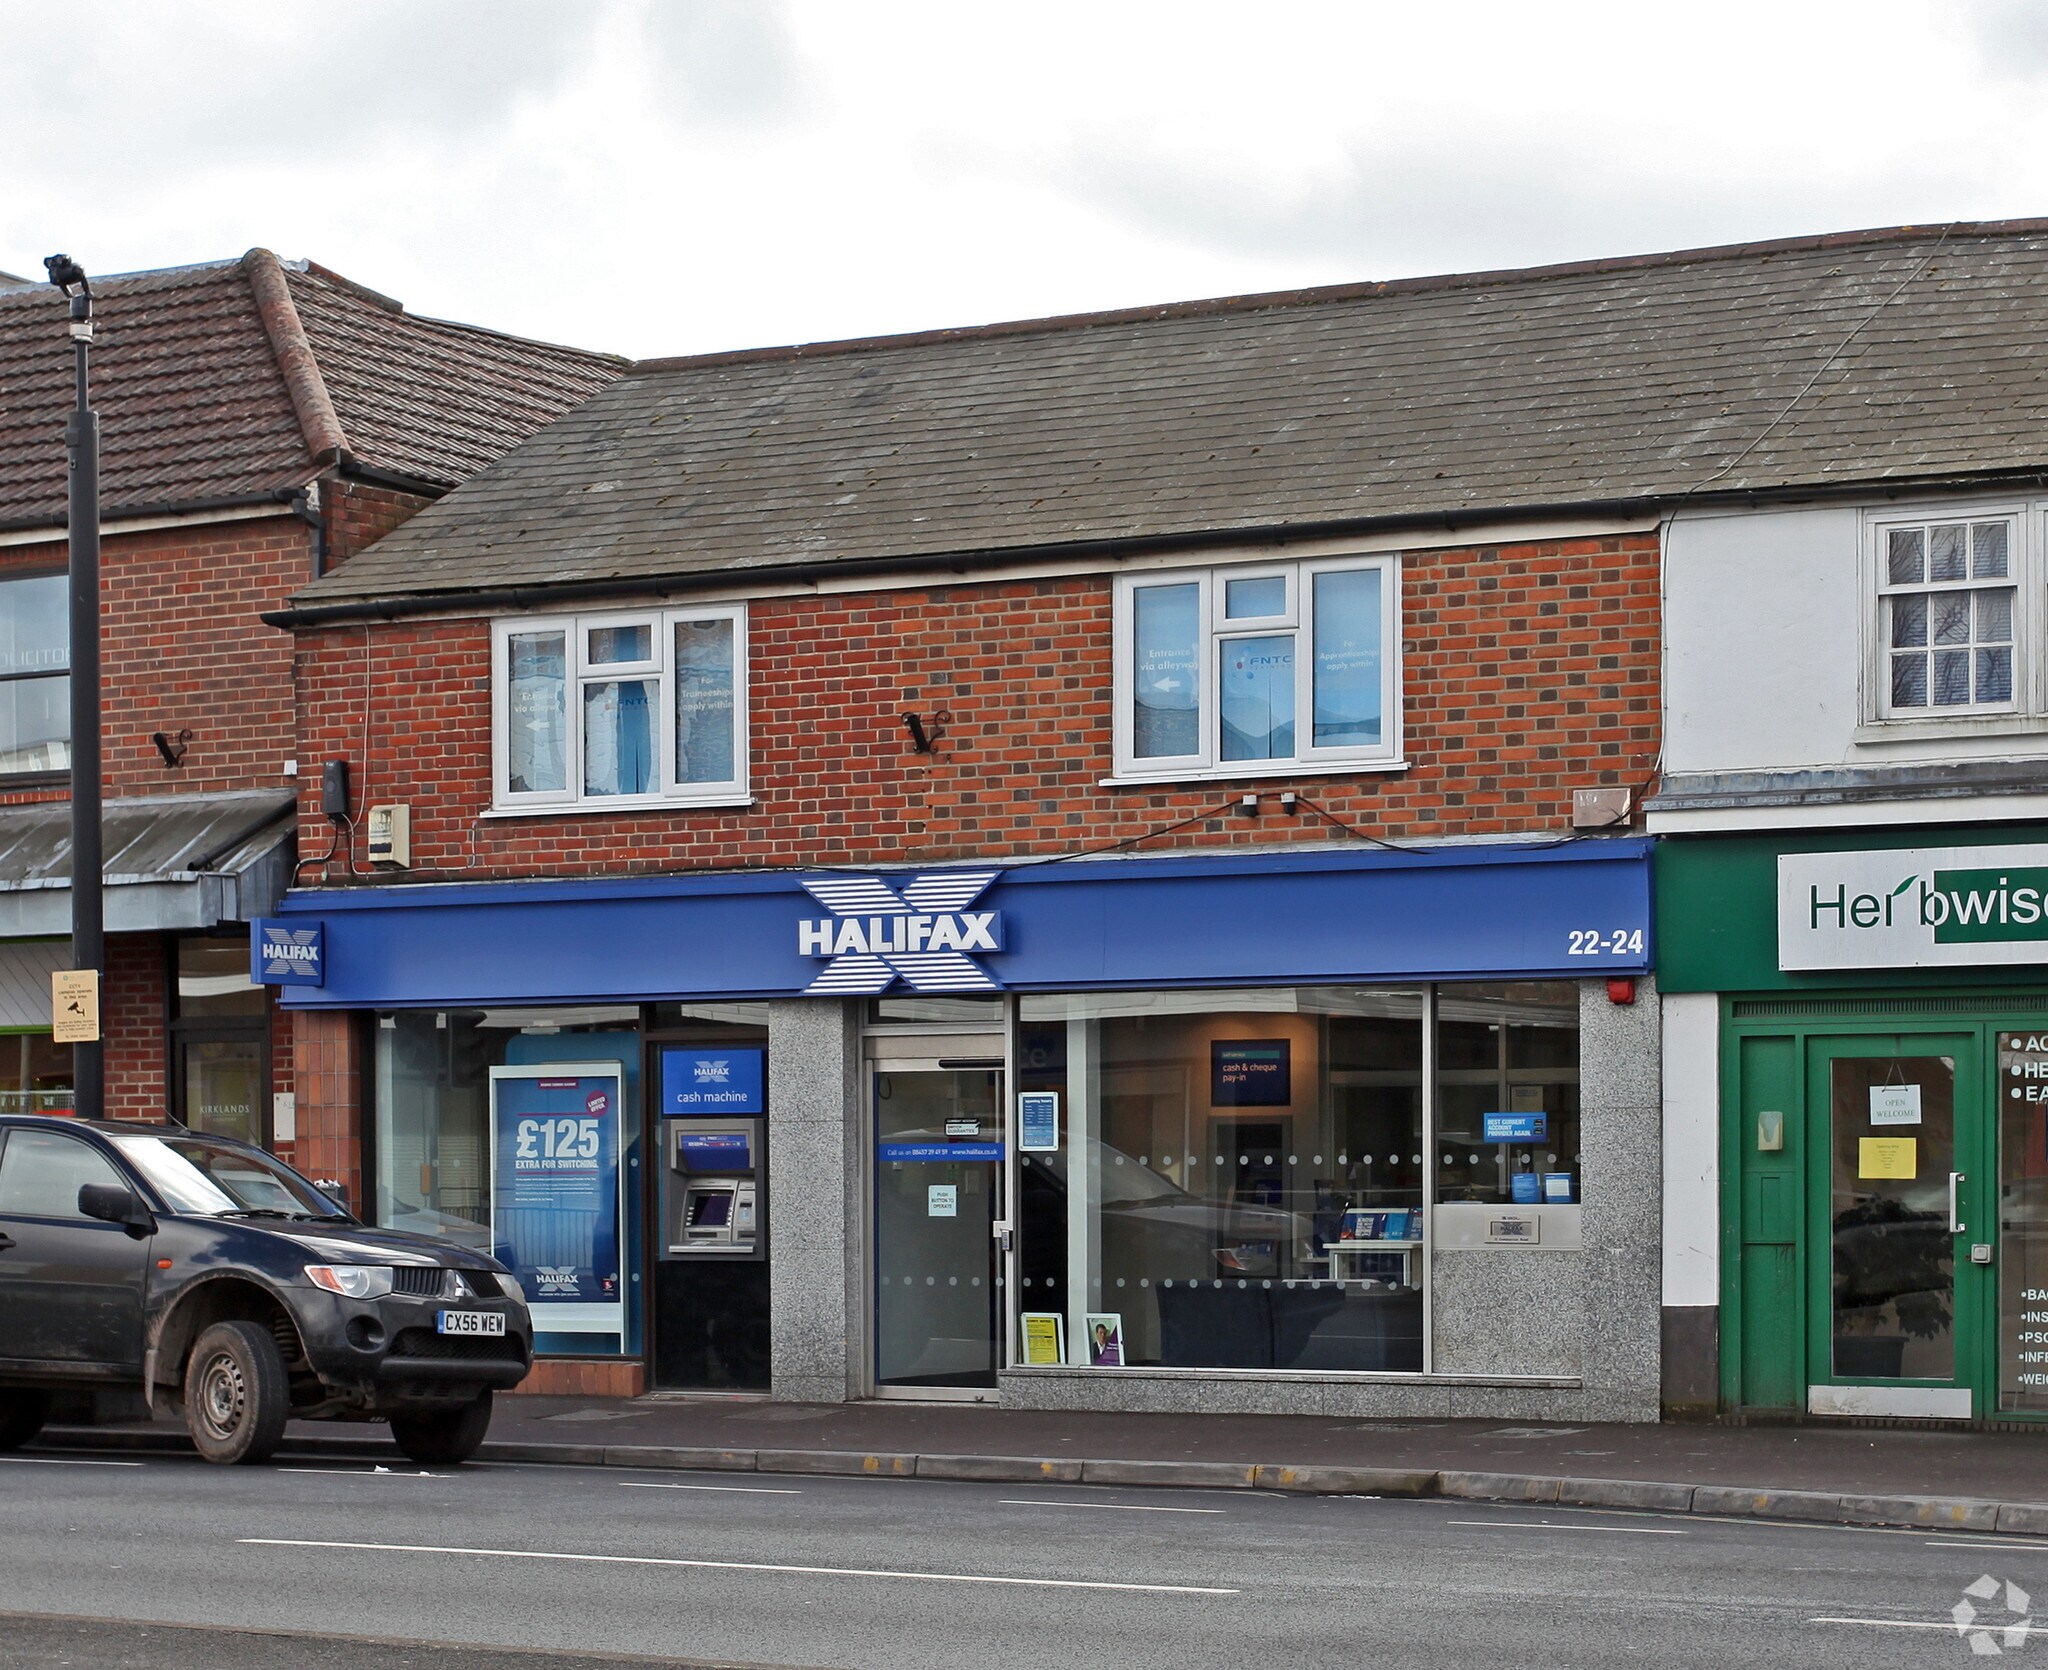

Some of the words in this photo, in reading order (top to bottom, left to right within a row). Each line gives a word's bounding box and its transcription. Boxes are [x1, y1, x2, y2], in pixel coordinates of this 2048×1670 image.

[1250, 655, 1292, 665] FNTC
[1140, 662, 1155, 671] via
[1809, 877, 2048, 930] Herbwis
[799, 912, 999, 956] HALIFAX
[1567, 929, 1644, 955] 22-24
[263, 943, 319, 961] HALIFAX
[694, 1067, 729, 1076] HALIFAX
[1223, 1063, 1240, 1072] cash
[1242, 1063, 1248, 1071] &
[1249, 1063, 1278, 1073] cheque
[1223, 1073, 1247, 1084] pay-in
[677, 1091, 701, 1103] cash
[704, 1090, 748, 1102] machine
[1884, 1099, 1906, 1107] OPEN
[200, 1105, 250, 1114] KIRKLANDS
[1876, 1110, 1915, 1118] WELCOME
[516, 1119, 599, 1158] £125
[515, 1160, 540, 1169] EXTRA
[541, 1160, 556, 1169] FOR
[536, 1274, 579, 1284] HALIFAX
[2027, 1289, 2048, 1300] BA
[446, 1314, 478, 1332] CX56
[2023, 1373, 2048, 1385] WEI
